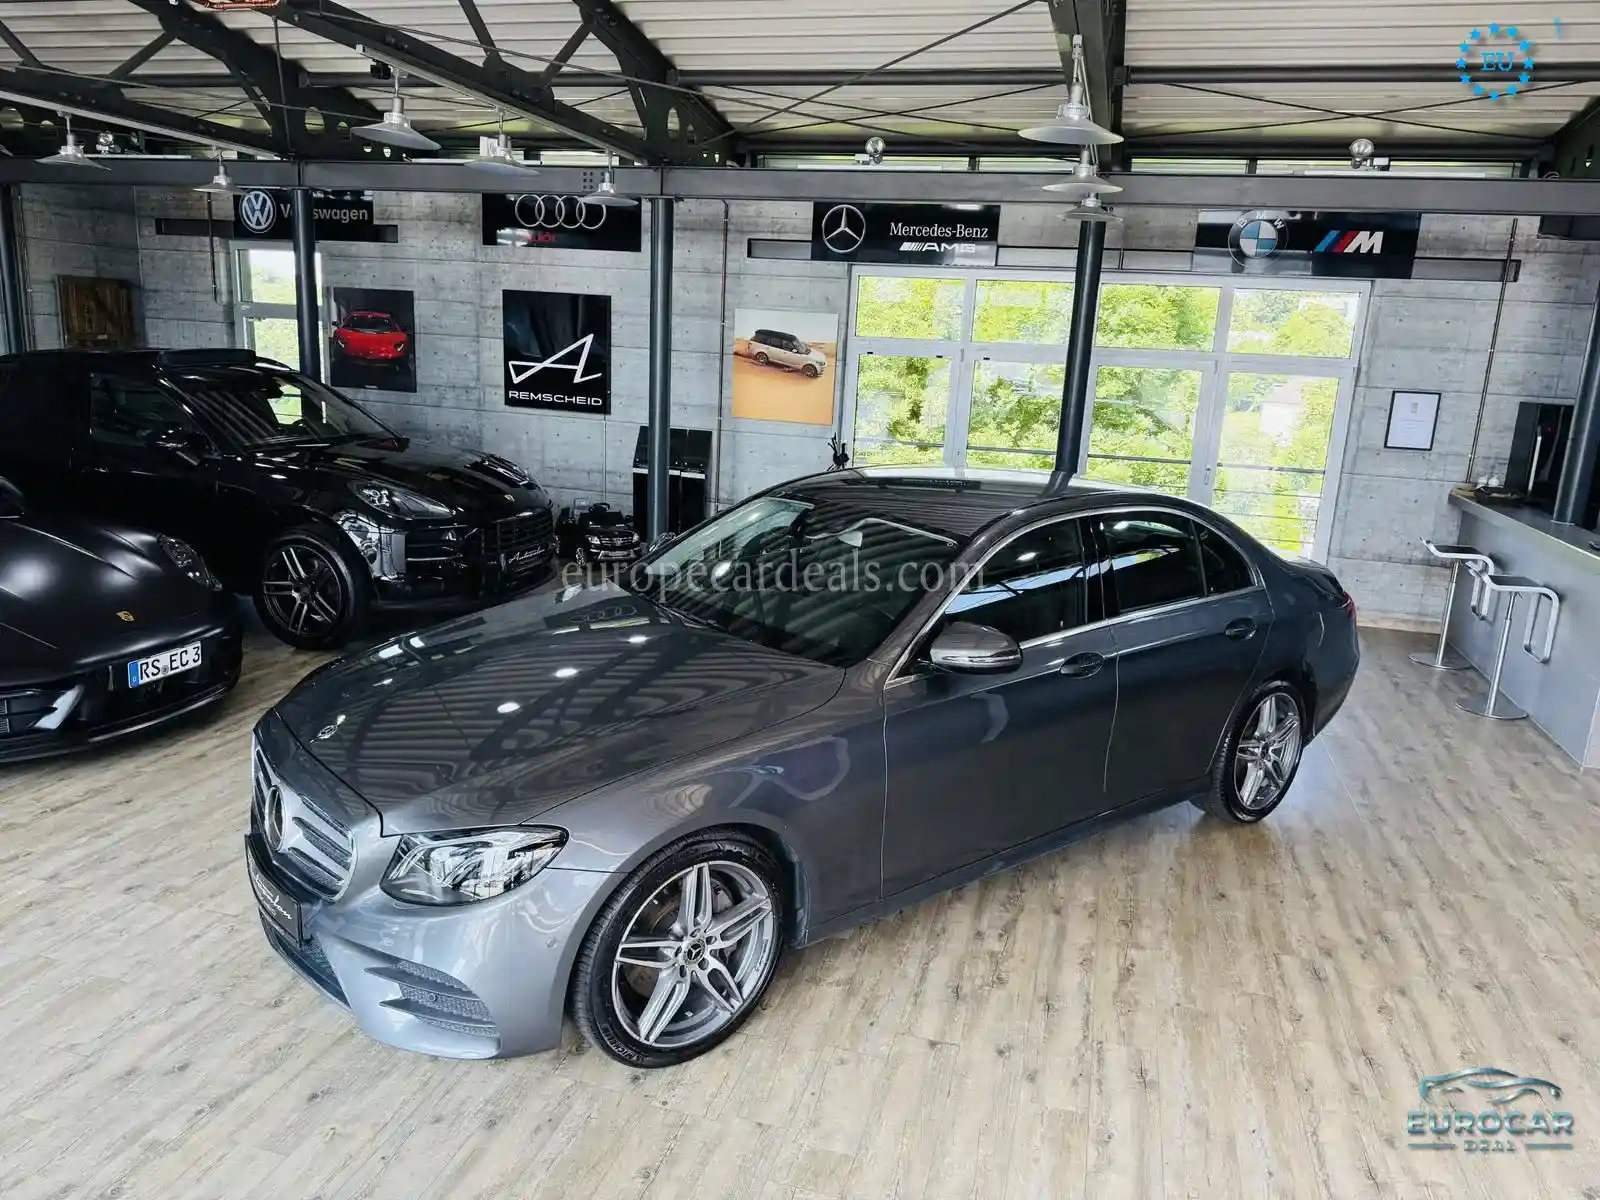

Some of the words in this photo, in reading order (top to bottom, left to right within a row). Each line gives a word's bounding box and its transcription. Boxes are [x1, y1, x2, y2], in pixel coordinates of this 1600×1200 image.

[280, 203, 369, 223] Vswagen
[527, 231, 556, 243] udi
[889, 222, 989, 239] Mercedes-Benz
[920, 242, 977, 254] AMG
[508, 390, 603, 406] REMSCHEID
[140, 659, 161, 681] RS
[169, 650, 189, 671] EC
[192, 646, 201, 663] 3
